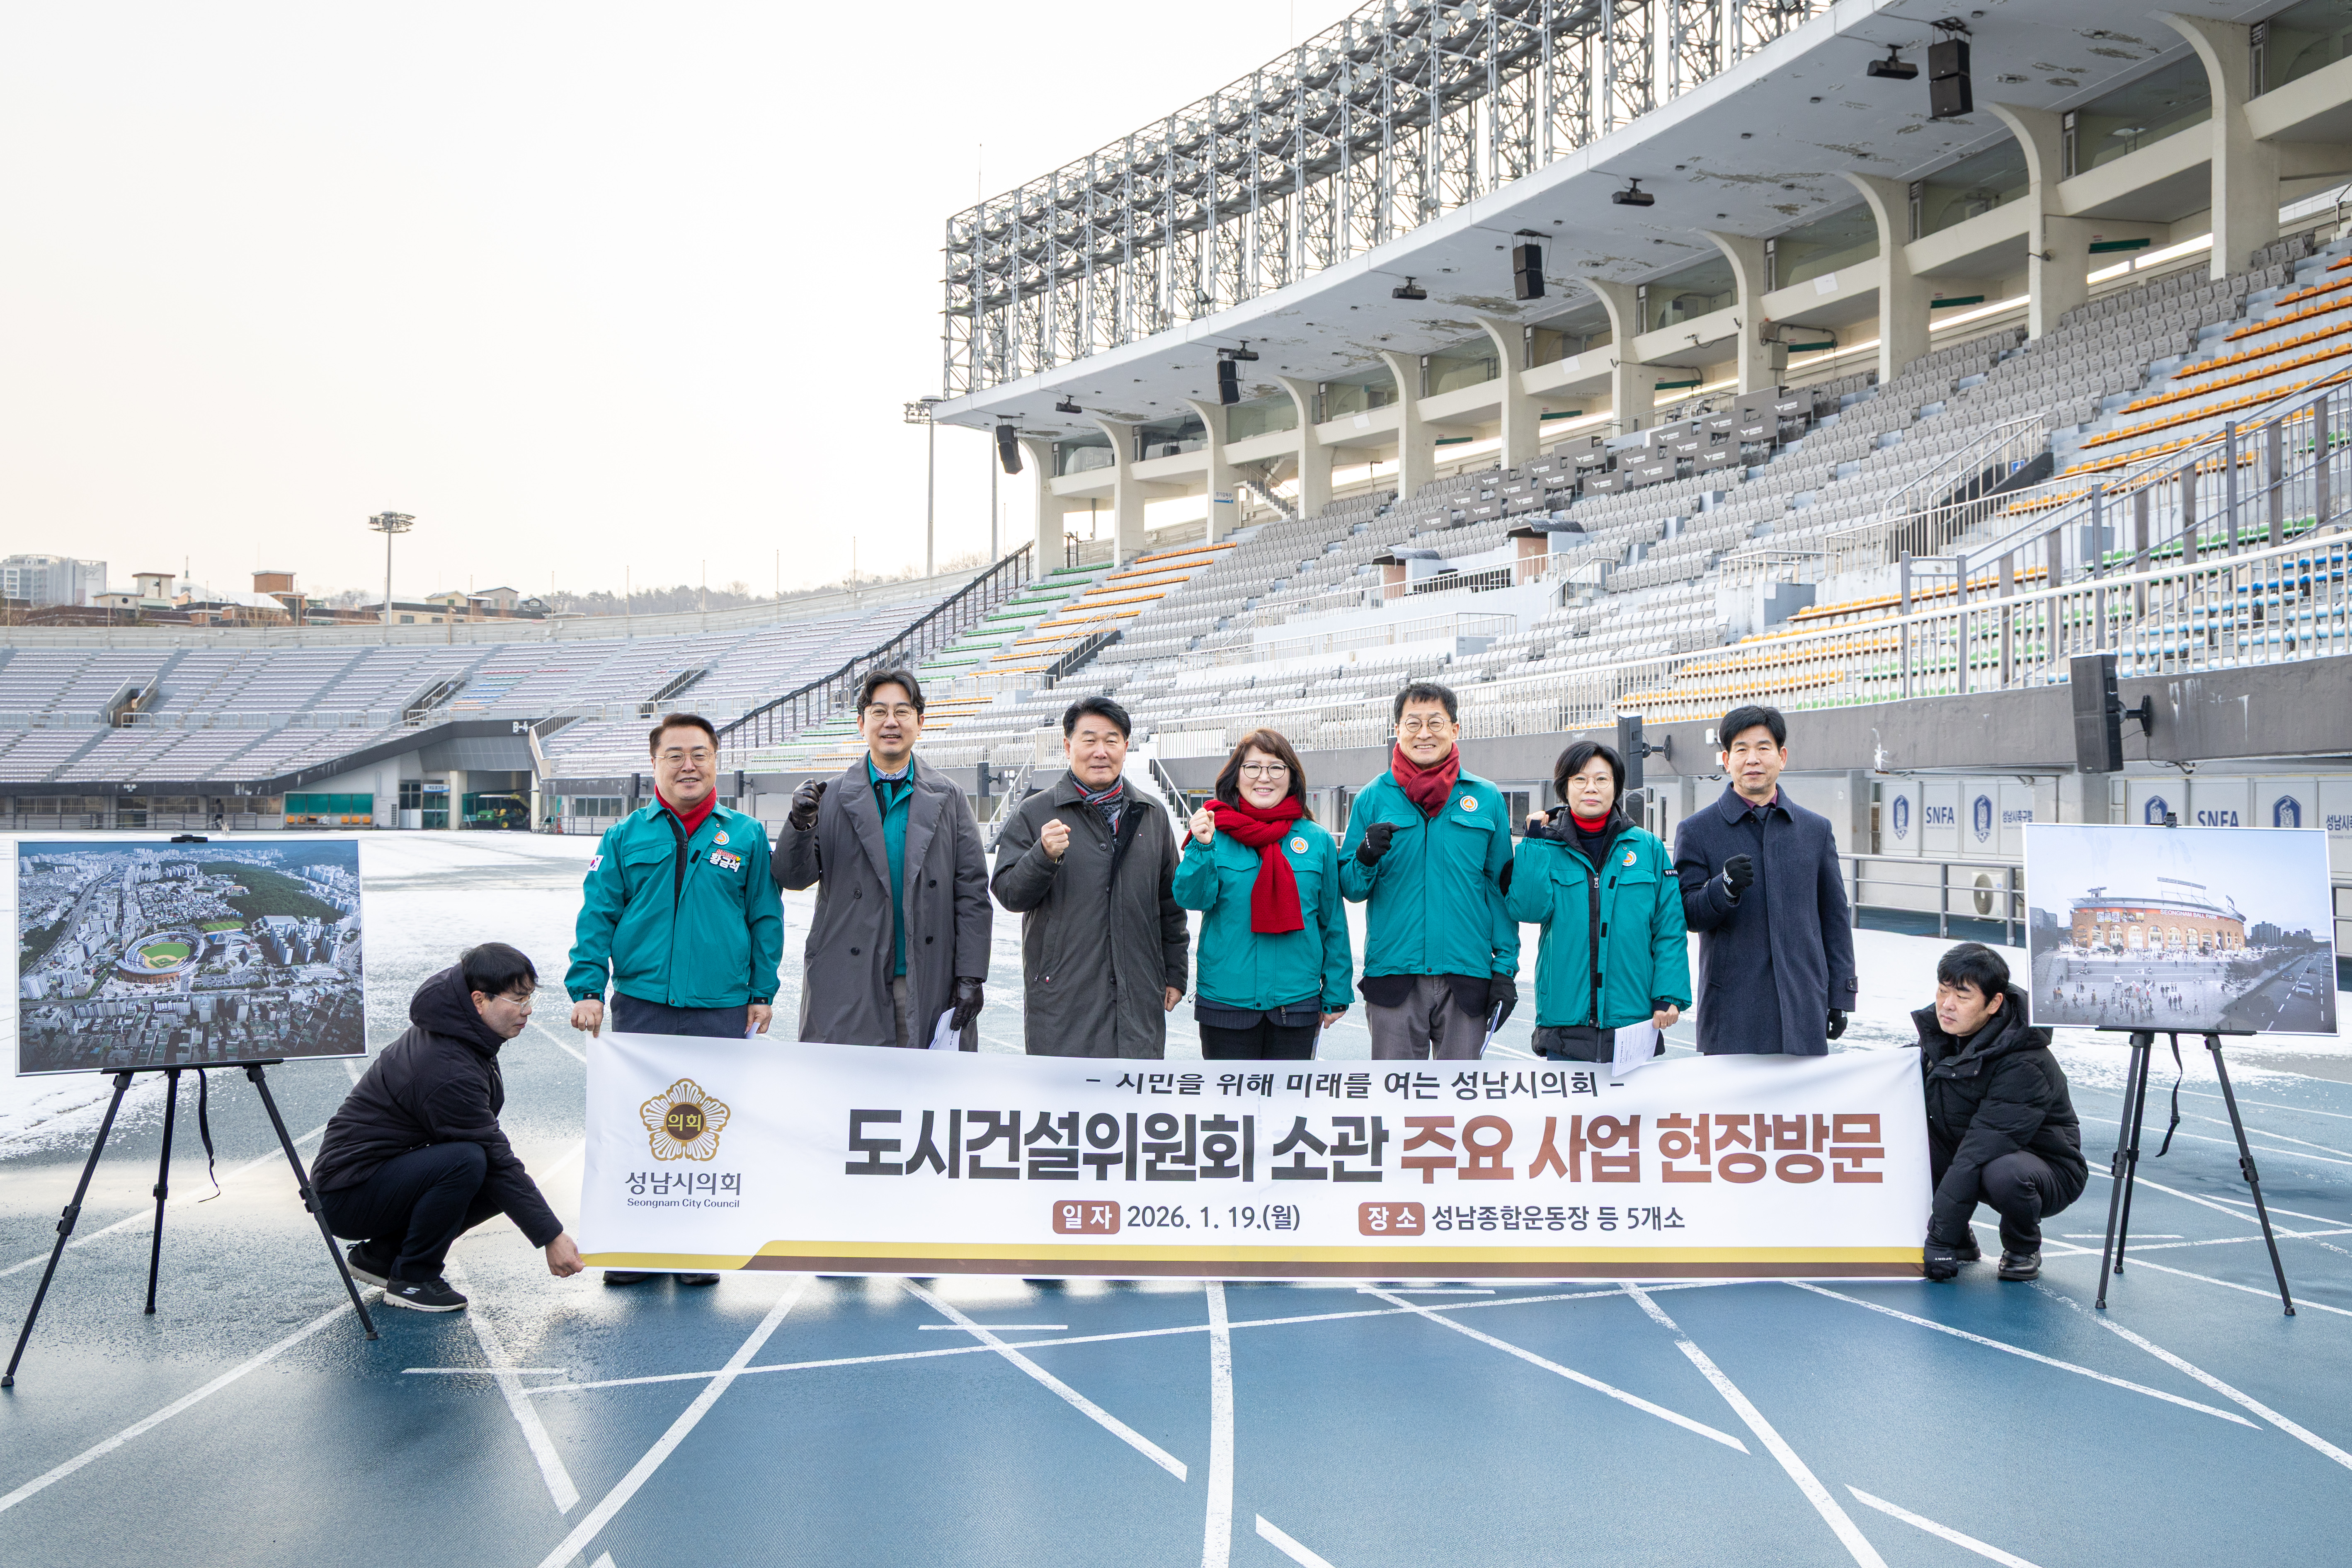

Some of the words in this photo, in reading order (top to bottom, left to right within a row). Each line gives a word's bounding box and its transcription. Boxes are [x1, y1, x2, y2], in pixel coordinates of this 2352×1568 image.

[512, 721, 529, 733] B-4
[1926, 806, 1954, 824] SNFA
[709, 852, 741, 872] 황금석
[1116, 1073, 1205, 1095] 시민을
[1217, 1074, 1274, 1097] 위해
[1287, 1073, 1371, 1099] 미래를
[1385, 1072, 1440, 1099] 여는
[1451, 1071, 1598, 1100] 성남시의회
[668, 1114, 701, 1131] 의회
[845, 1109, 1254, 1182] 도시건설위원회
[1272, 1116, 1389, 1182] 소관
[1401, 1115, 1514, 1184] 주요
[1529, 1115, 1641, 1183] 사업
[1656, 1113, 1885, 1184] 현장방문
[625, 1172, 741, 1195] 성남시의회
[627, 1198, 679, 1209] Seongnam
[682, 1199, 701, 1209] City
[704, 1199, 740, 1208] Council
[1128, 1205, 1190, 1229] 2026.
[1200, 1207, 1219, 1229] 1.
[1229, 1204, 1300, 1231] 19.(월)
[1432, 1206, 1589, 1231] 성남종합운동장
[1597, 1207, 1618, 1231] 등
[1628, 1207, 1685, 1231] 5개소
